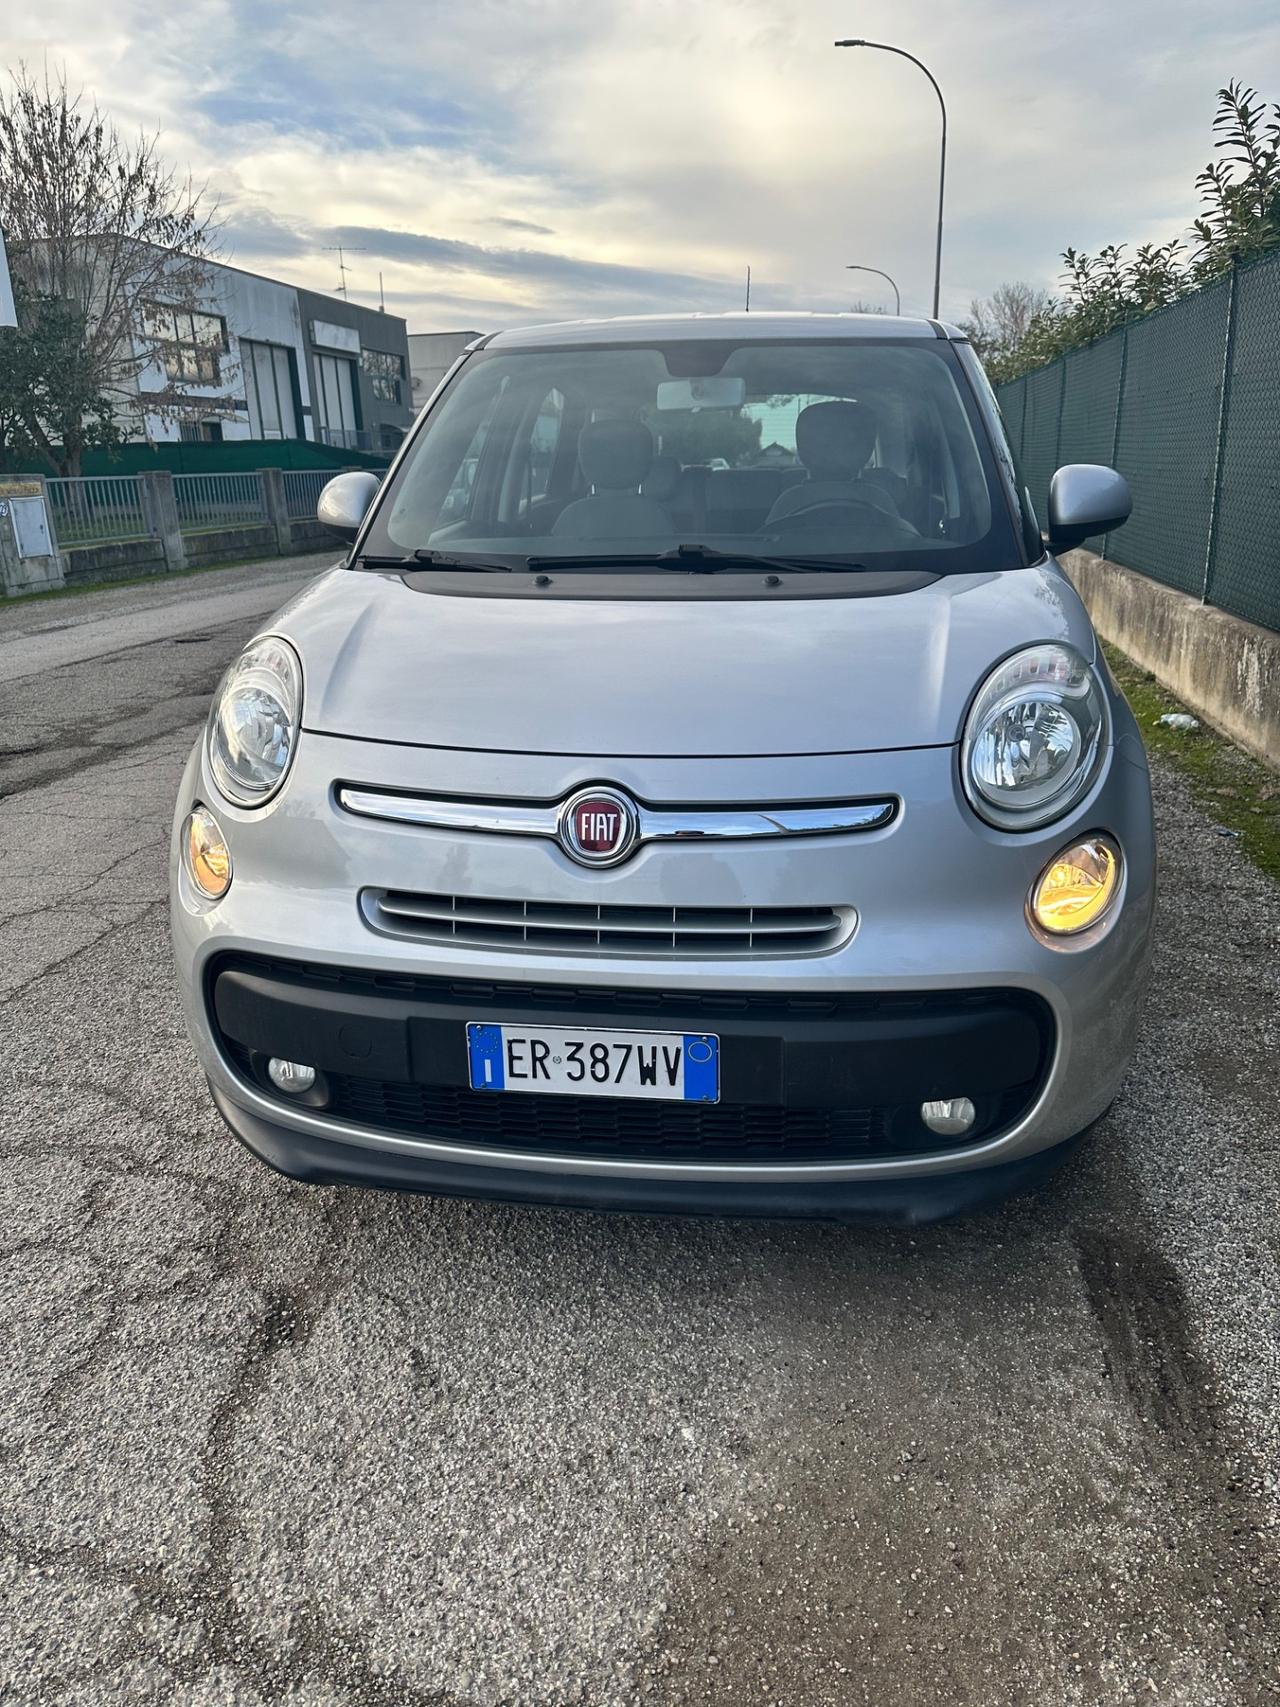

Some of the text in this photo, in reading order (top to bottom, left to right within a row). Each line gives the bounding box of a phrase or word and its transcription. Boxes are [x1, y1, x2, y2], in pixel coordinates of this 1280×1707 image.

[581, 813, 618, 841] FIAT
[484, 1059, 492, 1083] I
[507, 1038, 682, 1087] ER 387WV
